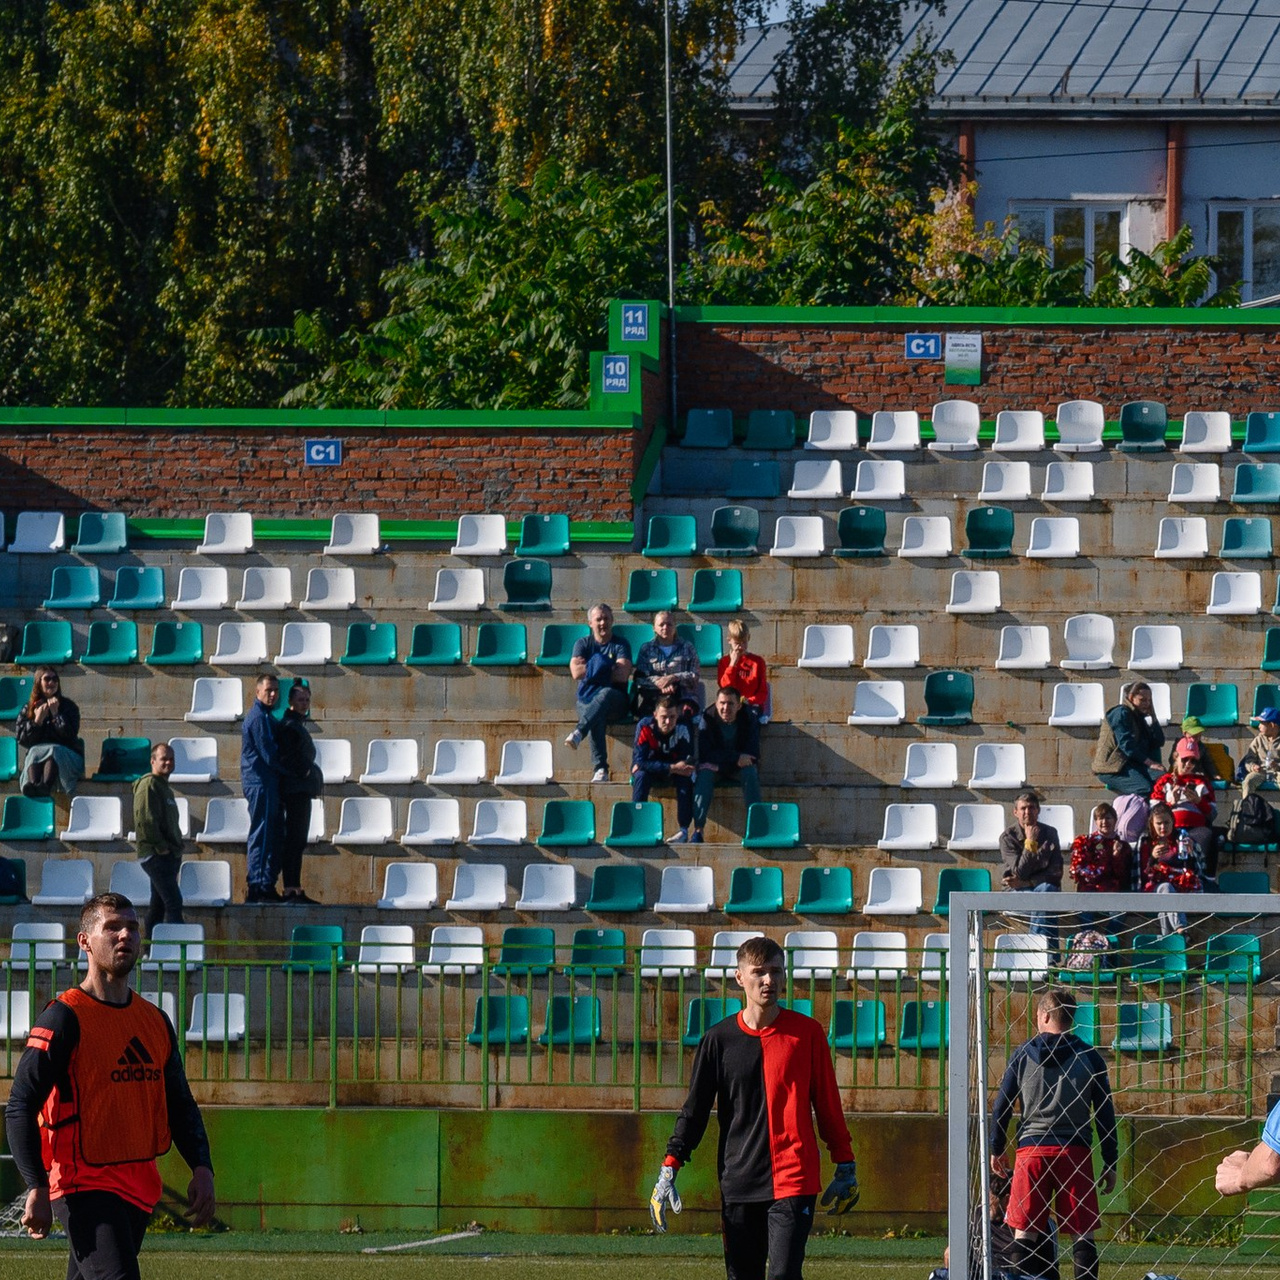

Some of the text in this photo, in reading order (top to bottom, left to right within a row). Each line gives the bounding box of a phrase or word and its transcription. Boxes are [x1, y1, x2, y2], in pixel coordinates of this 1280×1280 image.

[625, 310, 643, 323] 11
[625, 326, 645, 335] РЯД
[911, 338, 935, 354] С1
[606, 362, 626, 375] 10
[606, 378, 626, 387] РЯД
[311, 444, 335, 460] С1
[110, 1065, 162, 1082] adidas
